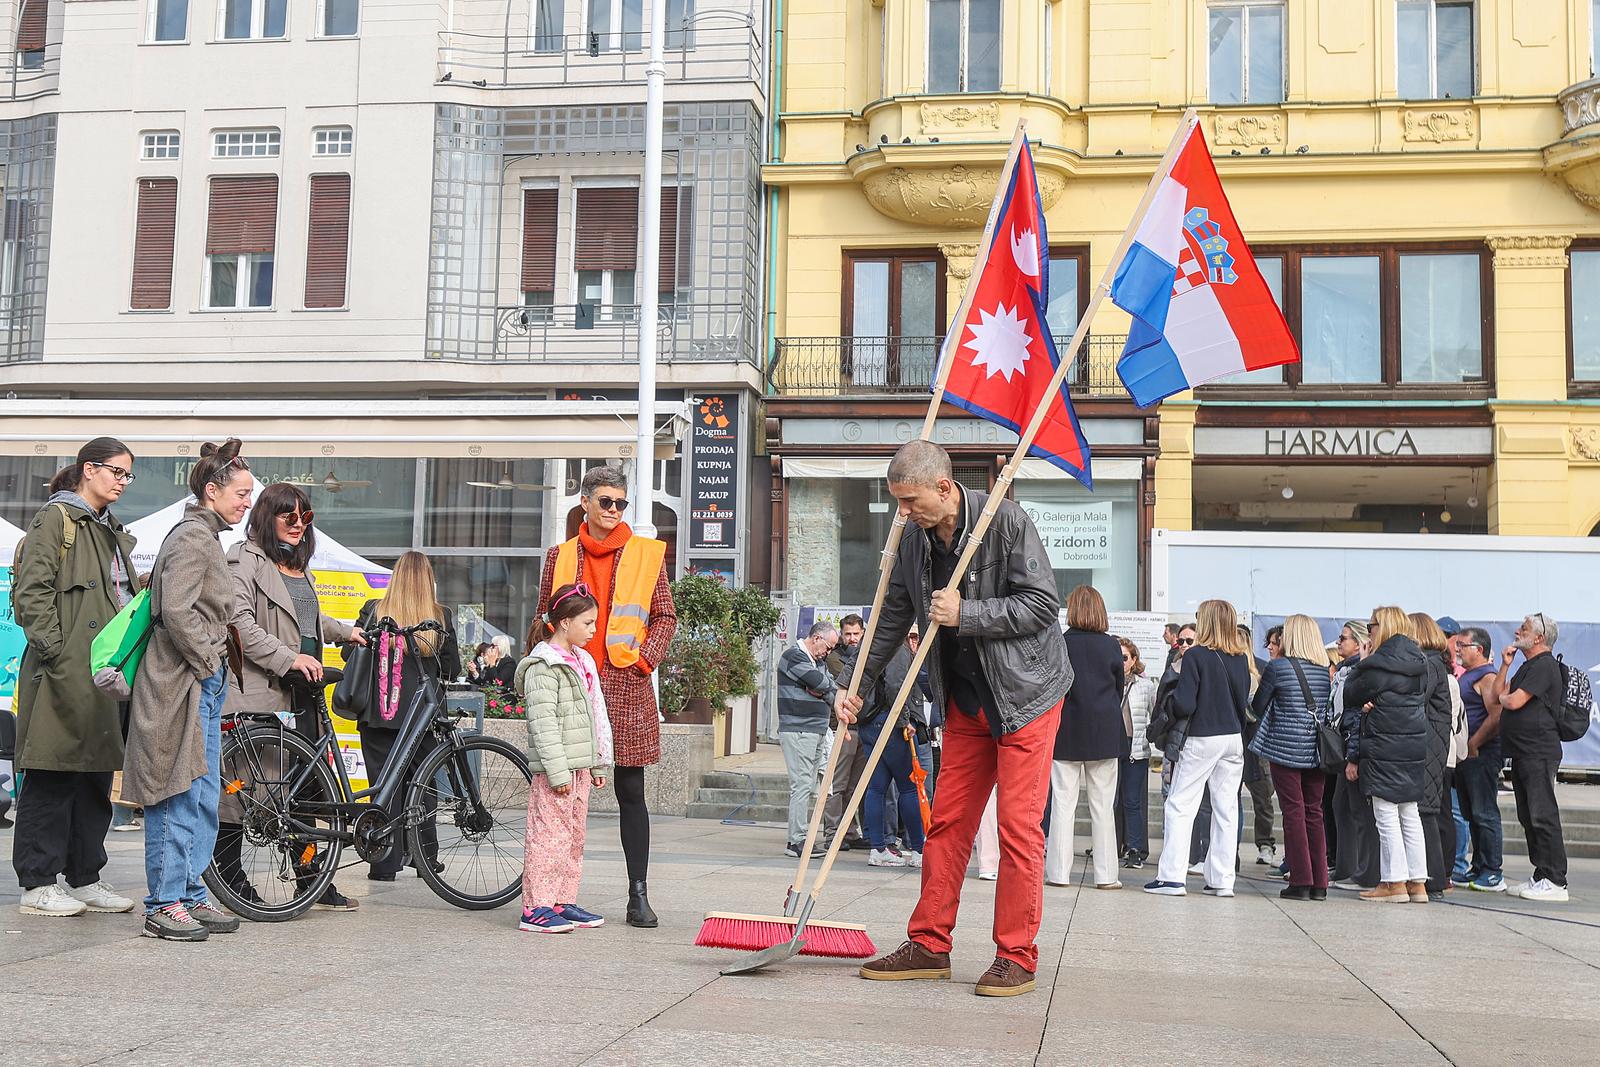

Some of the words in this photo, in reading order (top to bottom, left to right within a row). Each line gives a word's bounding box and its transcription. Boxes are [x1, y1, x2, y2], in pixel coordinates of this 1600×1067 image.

[695, 426, 727, 438] Dogma
[1265, 429, 1418, 456] HARMICA
[695, 446, 735, 455] PRODAJA
[697, 461, 732, 470] KUPNJA
[699, 476, 729, 485] NAJAM
[698, 491, 729, 499] ZAKUP
[1042, 512, 1081, 524] Galerija
[1083, 511, 1107, 521] Mala
[1054, 536, 1096, 548] zidom
[1099, 536, 1107, 548] 8
[1063, 552, 1108, 561] Dobrodošli
